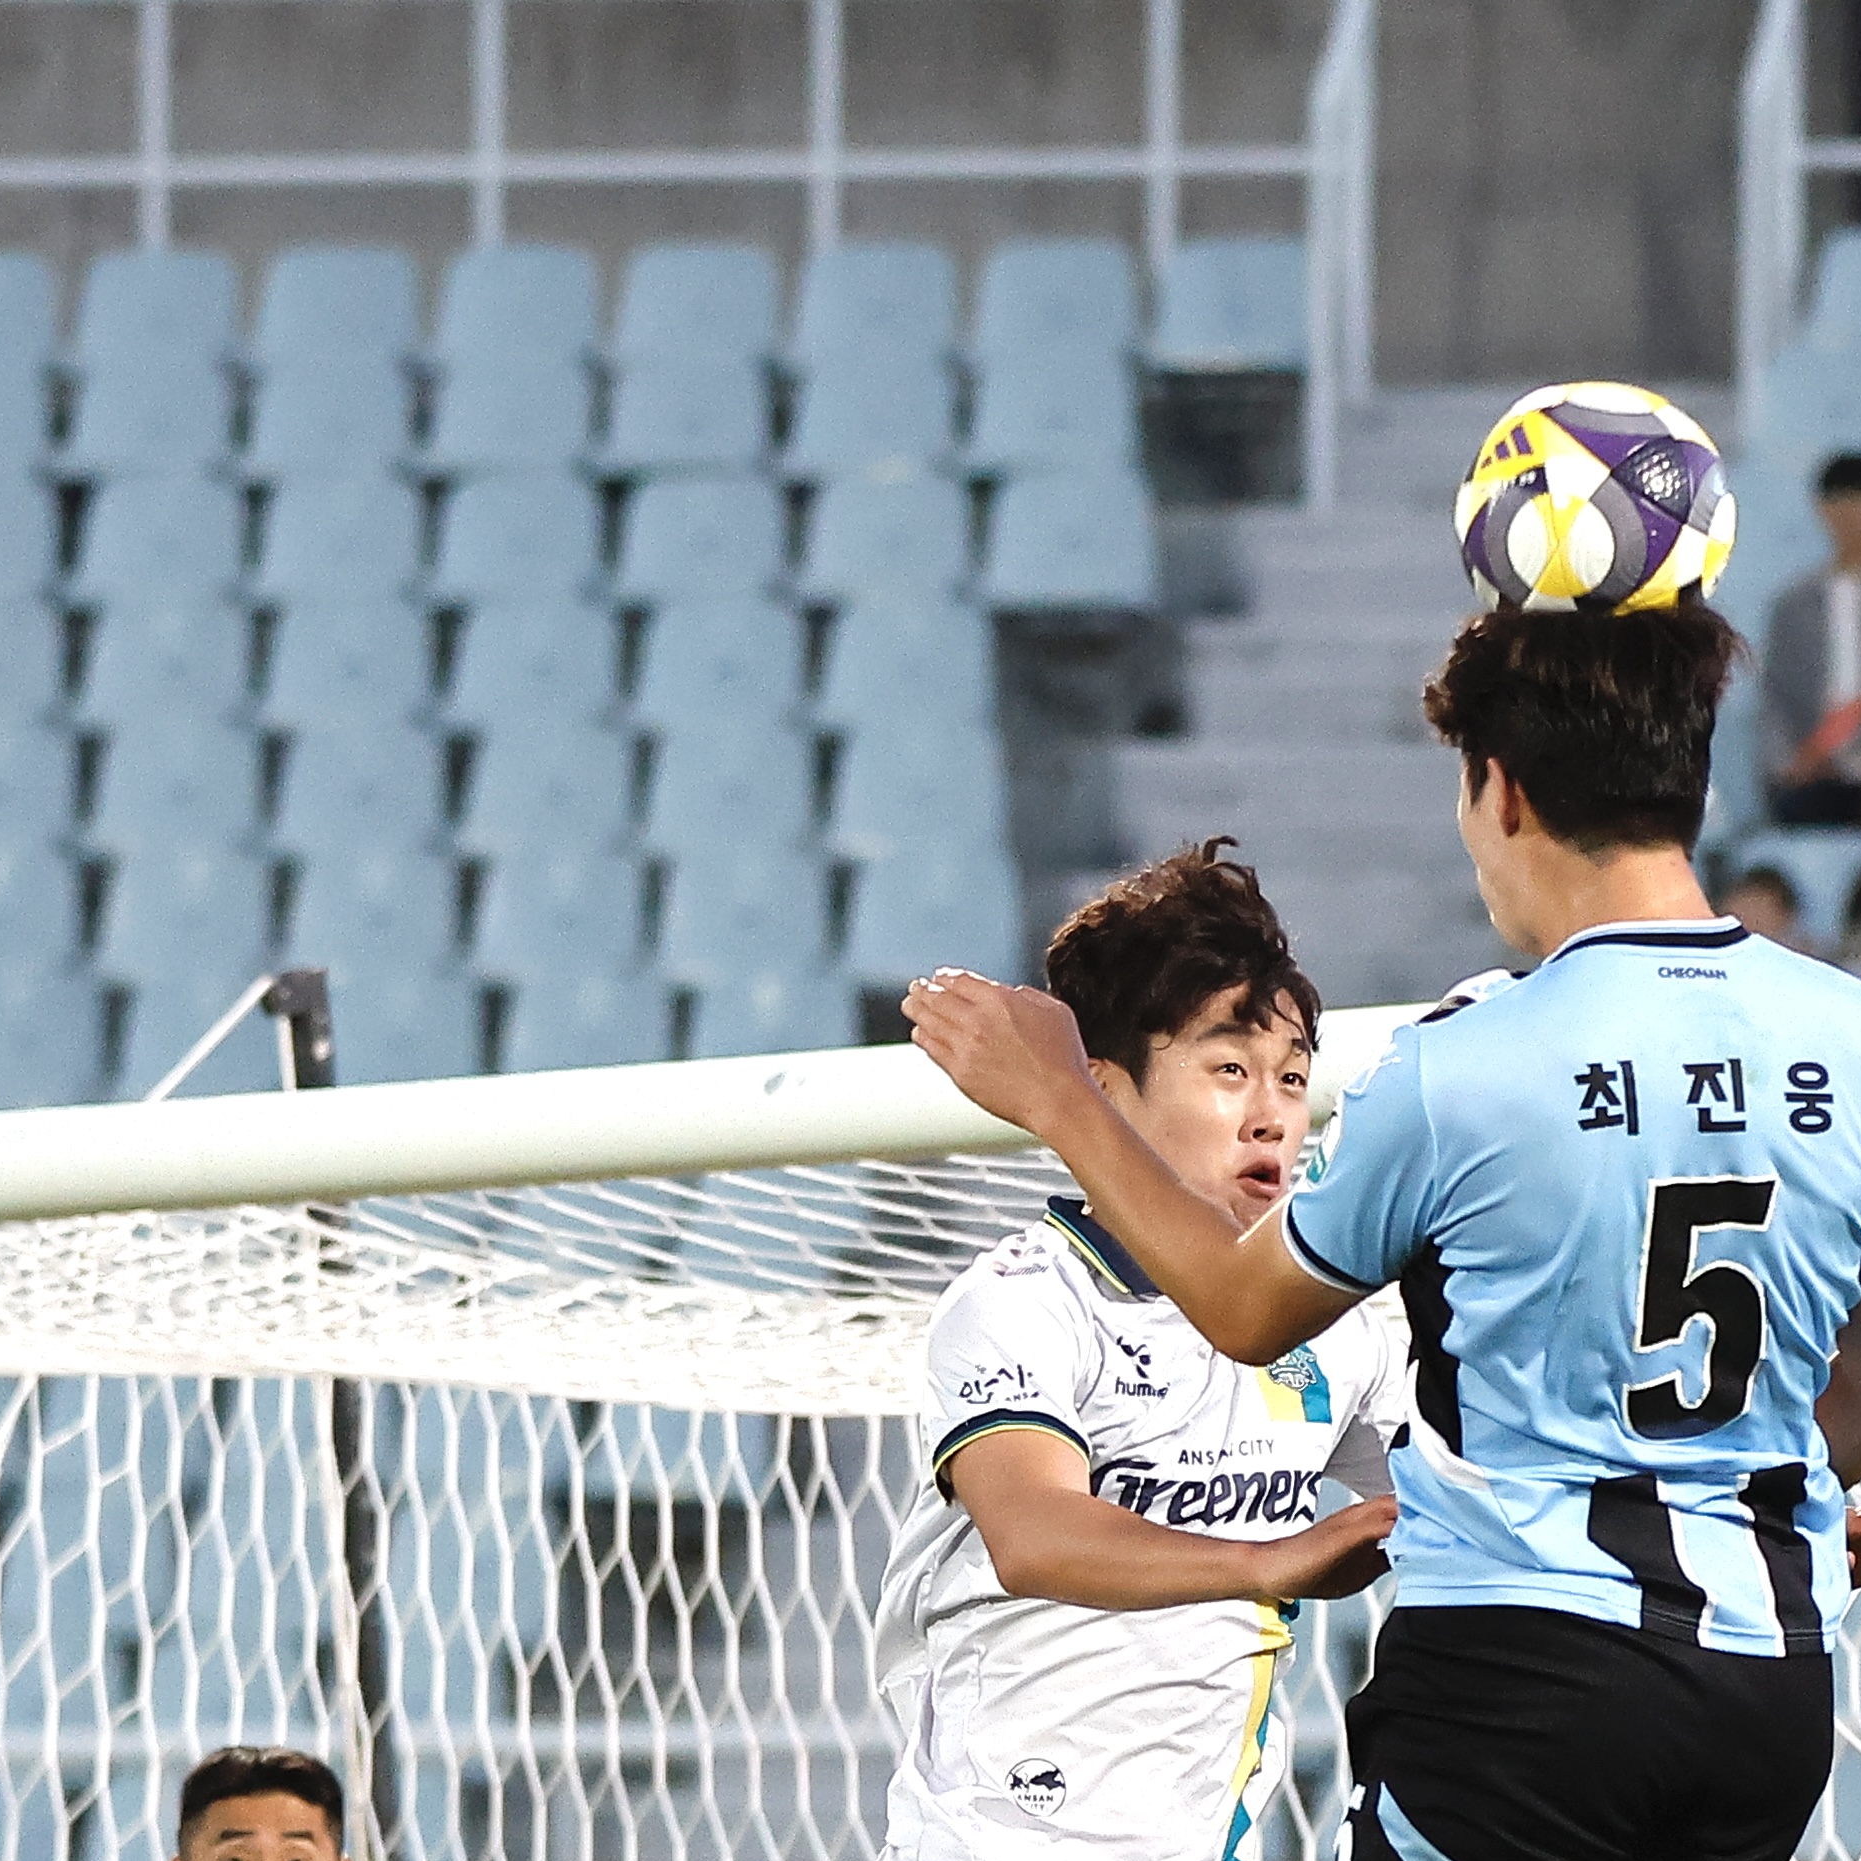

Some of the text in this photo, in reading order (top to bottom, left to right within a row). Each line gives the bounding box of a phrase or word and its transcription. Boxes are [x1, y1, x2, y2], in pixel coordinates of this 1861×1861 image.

[1621, 1175, 1780, 1442] 5
[1177, 1438, 1276, 1466] ANSA CITY
